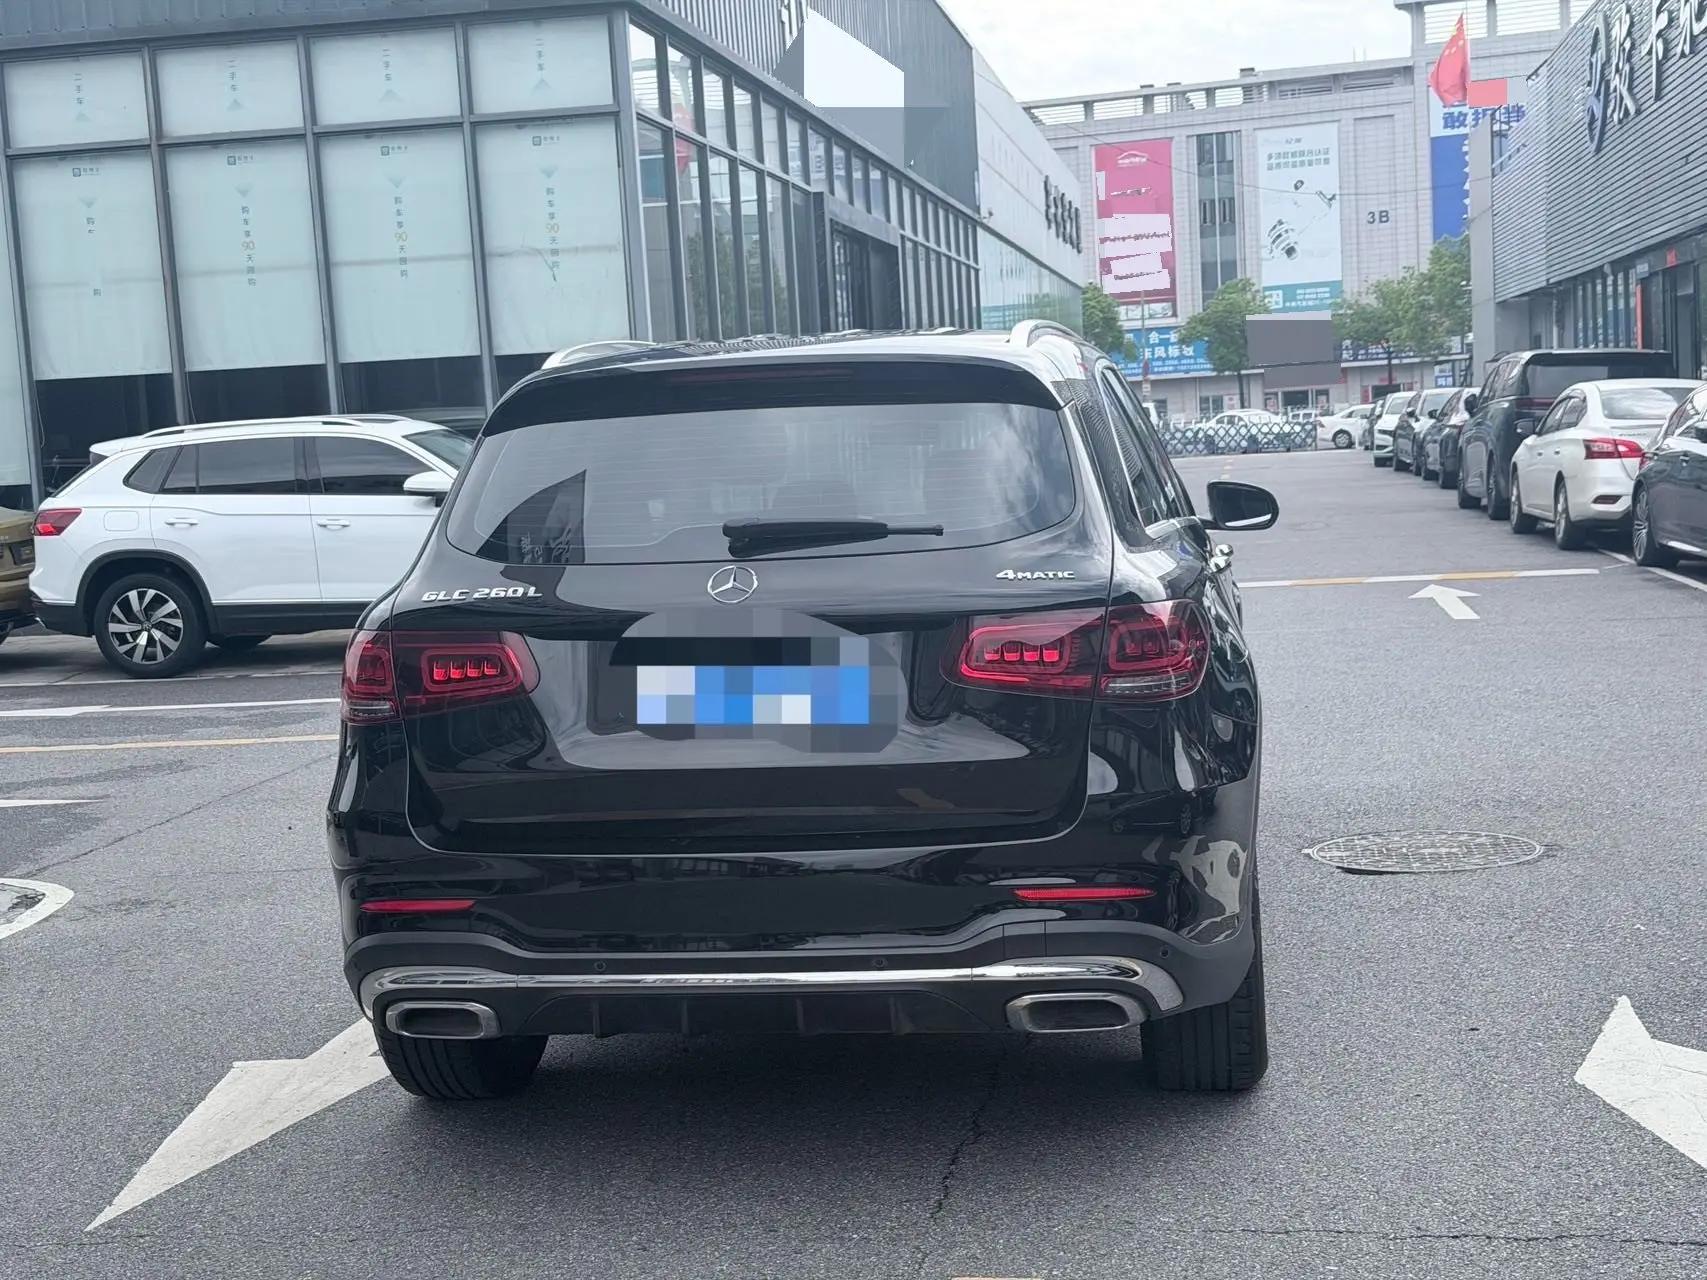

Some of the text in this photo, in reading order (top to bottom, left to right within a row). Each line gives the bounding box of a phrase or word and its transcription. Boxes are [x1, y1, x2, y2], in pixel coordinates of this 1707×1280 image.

[1367, 209, 1390, 224] 3B
[996, 569, 1076, 581] 4MATIC
[421, 586, 543, 601] GLC 260 L
